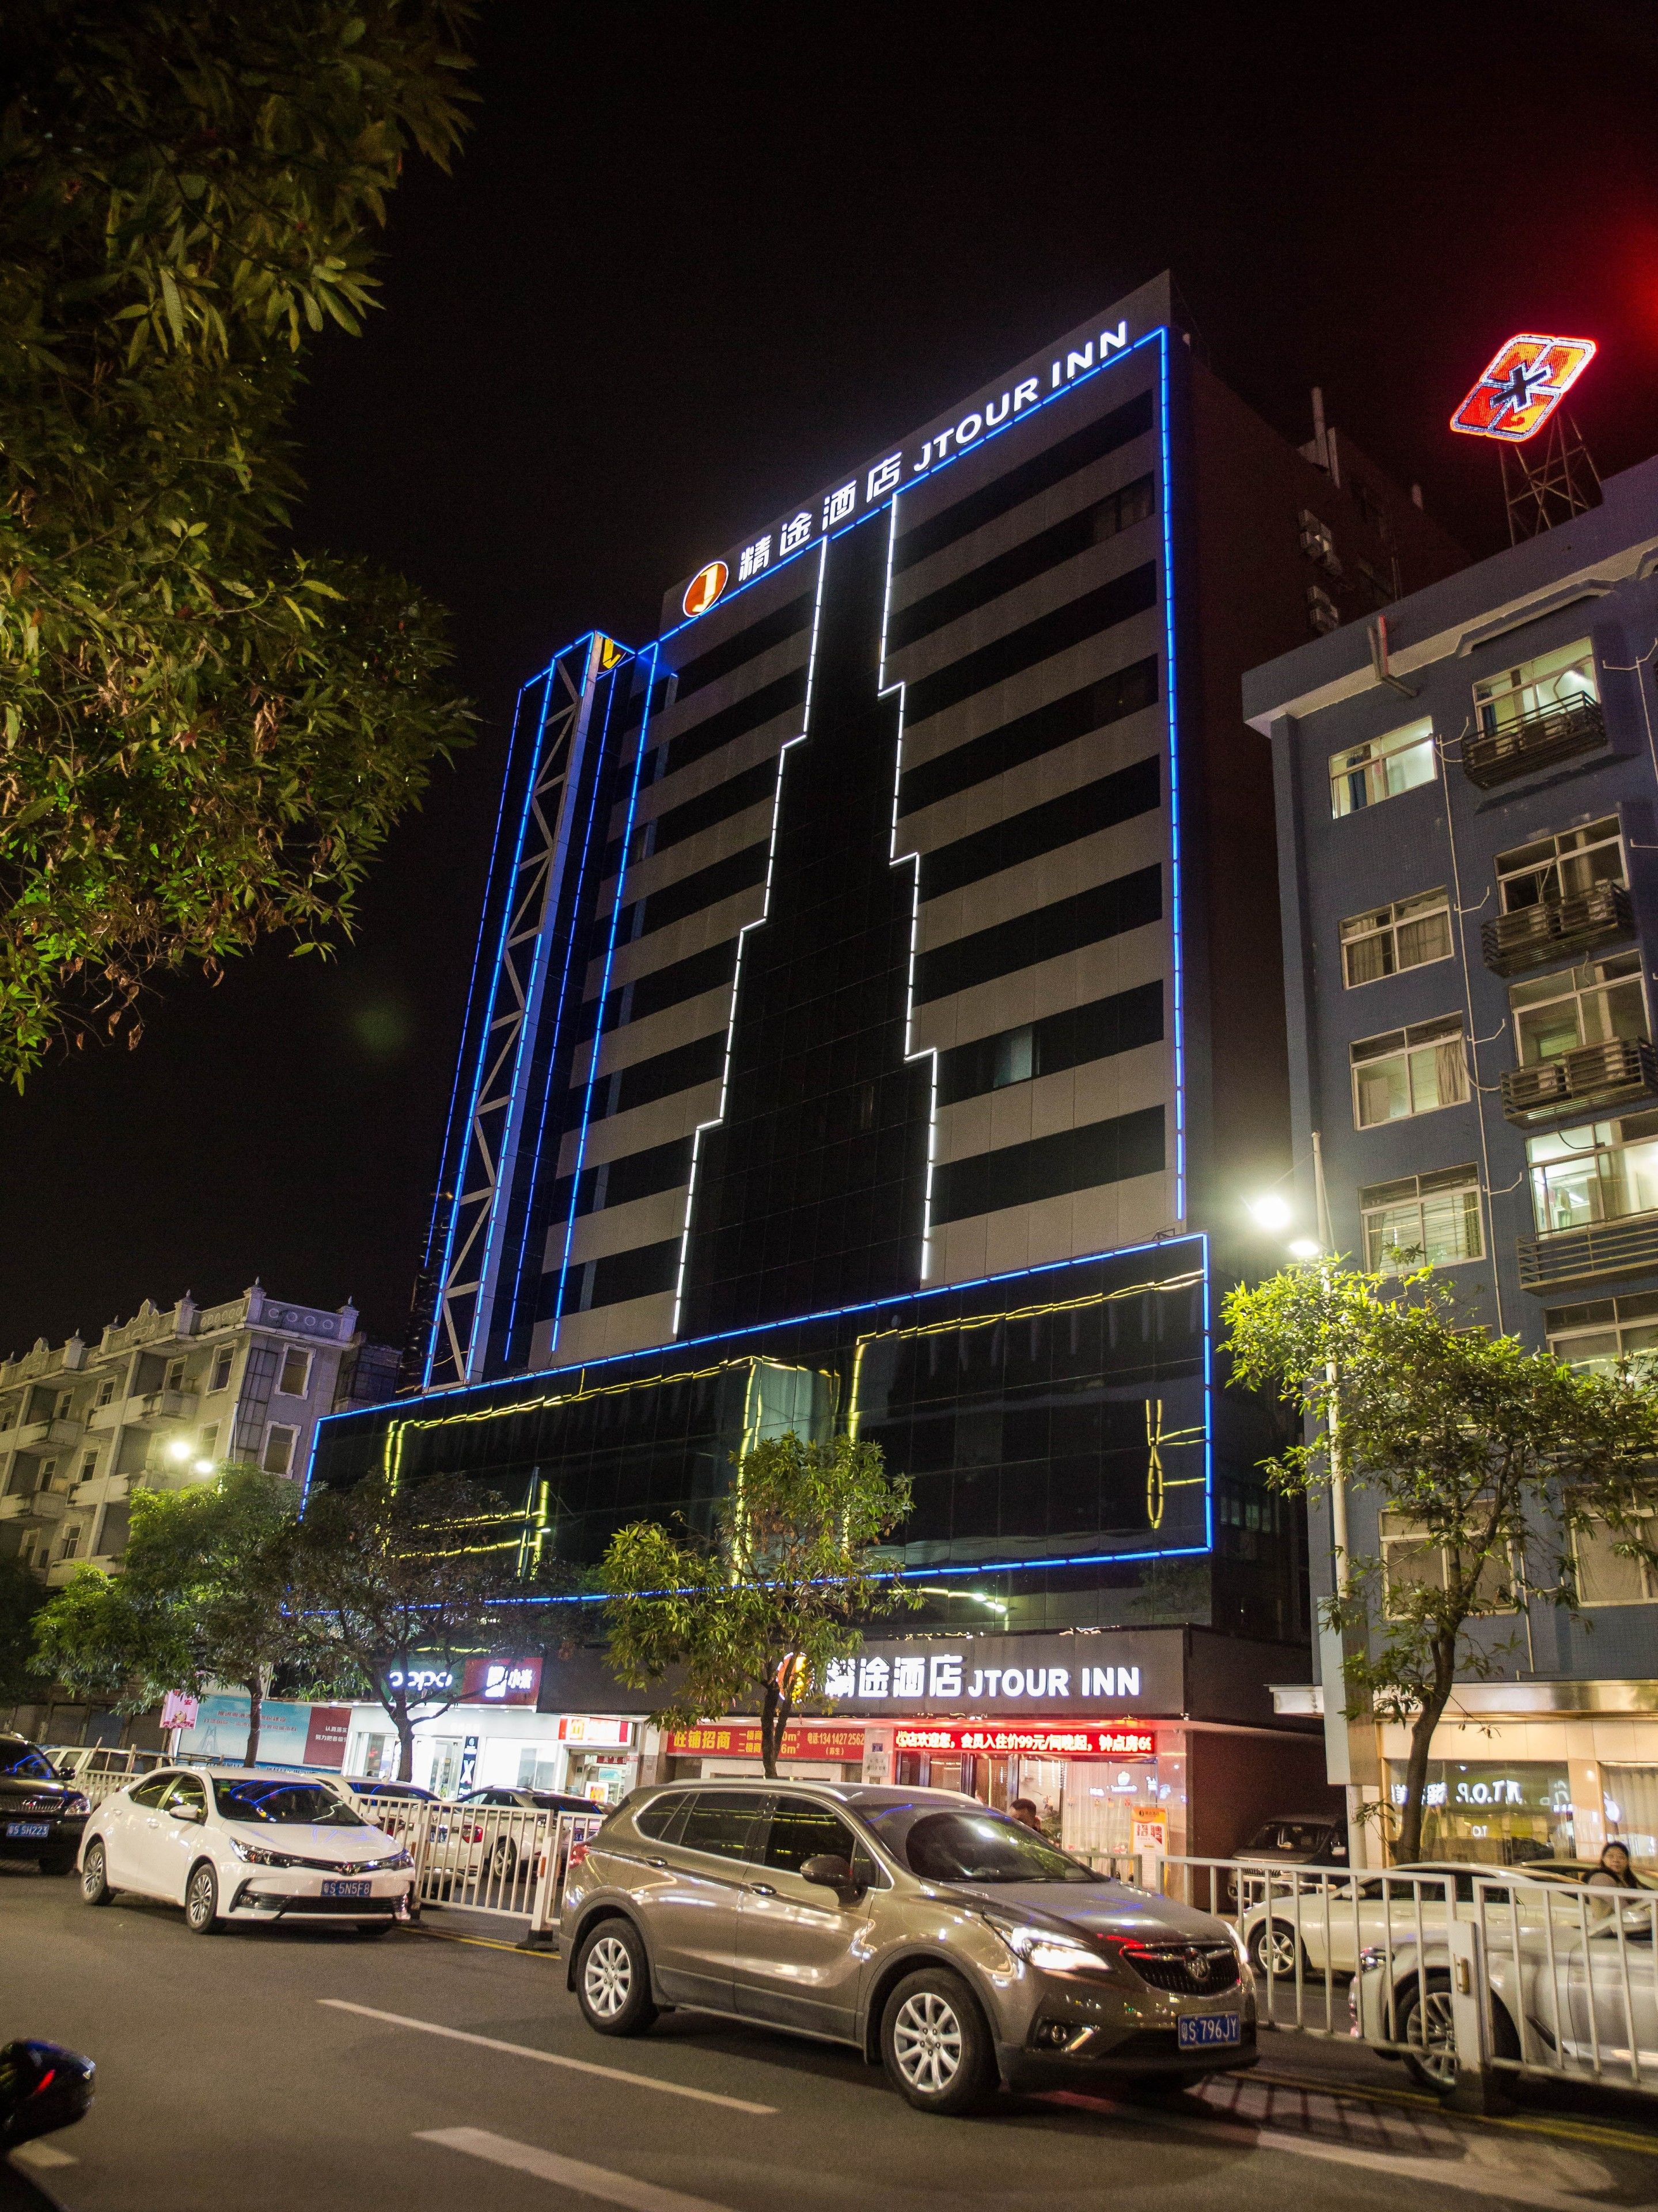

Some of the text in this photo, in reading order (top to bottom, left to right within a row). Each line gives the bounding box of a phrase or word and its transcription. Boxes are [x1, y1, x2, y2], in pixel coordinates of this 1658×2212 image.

[913, 320, 1127, 472] JTOUR INN
[738, 450, 903, 582] 精途酒店
[968, 1666, 1141, 1698] JTOUR INN
[673, 1730, 731, 1750] 旺铺招商
